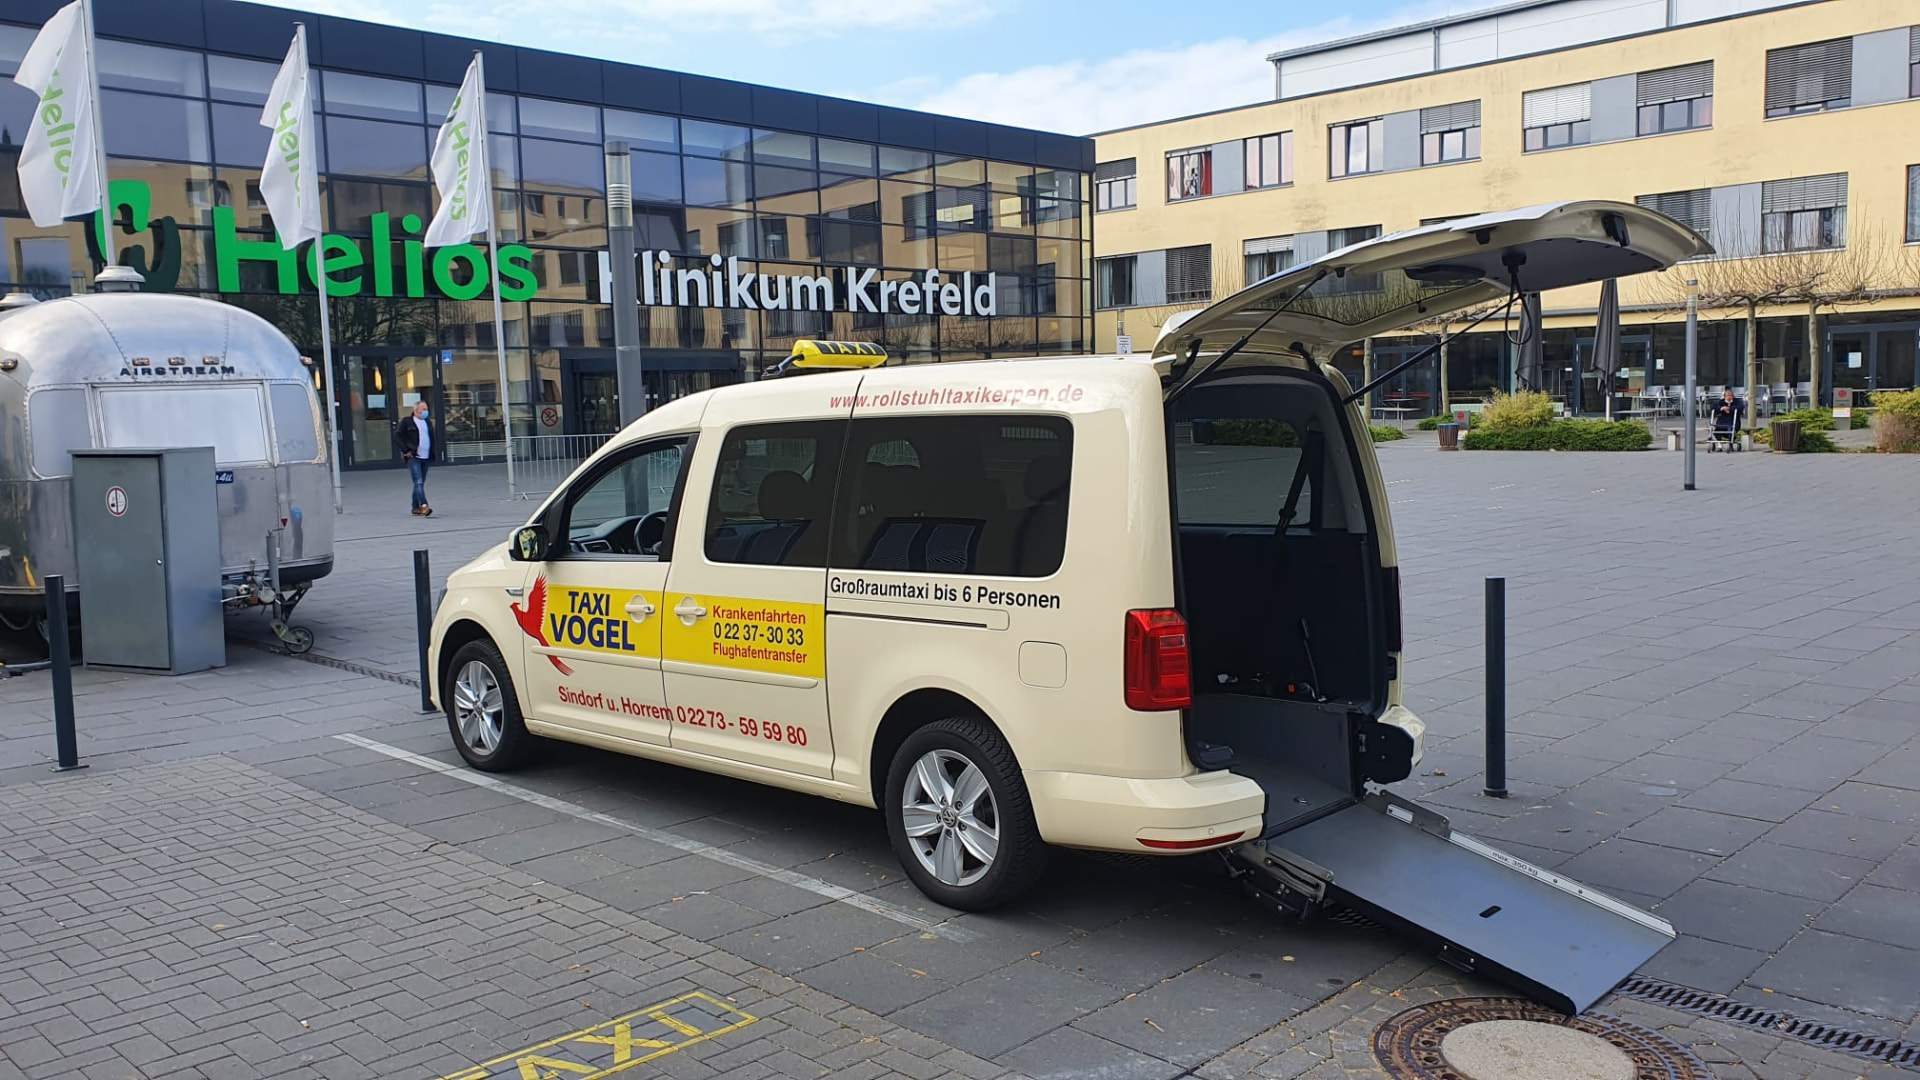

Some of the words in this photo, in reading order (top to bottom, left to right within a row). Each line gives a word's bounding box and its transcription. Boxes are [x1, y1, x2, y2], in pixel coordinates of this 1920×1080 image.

[213, 206, 538, 301] Helios
[847, 267, 996, 316] Krefeld
[820, 342, 877, 355] TAXI
[120, 366, 235, 376] AIRSTREAM
[830, 384, 1083, 409] www.rollstuhltaxikerpen.de
[568, 591, 610, 616] TAXI
[830, 577, 929, 599] Großraumtaxi
[934, 580, 957, 602] bis
[962, 585, 972, 603] 6
[977, 586, 1061, 609] Personen
[713, 605, 806, 625] Krankenfahrten
[550, 613, 635, 651] VOGEL
[713, 642, 807, 664] Flughafentransfer
[558, 686, 604, 710] Sindorf
[607, 698, 619, 713] u.
[621, 696, 674, 721] Horrem
[739, 717, 758, 737] 59
[762, 721, 782, 742] 59
[787, 726, 807, 746] 80
[456, 1012, 702, 1080] AXI
